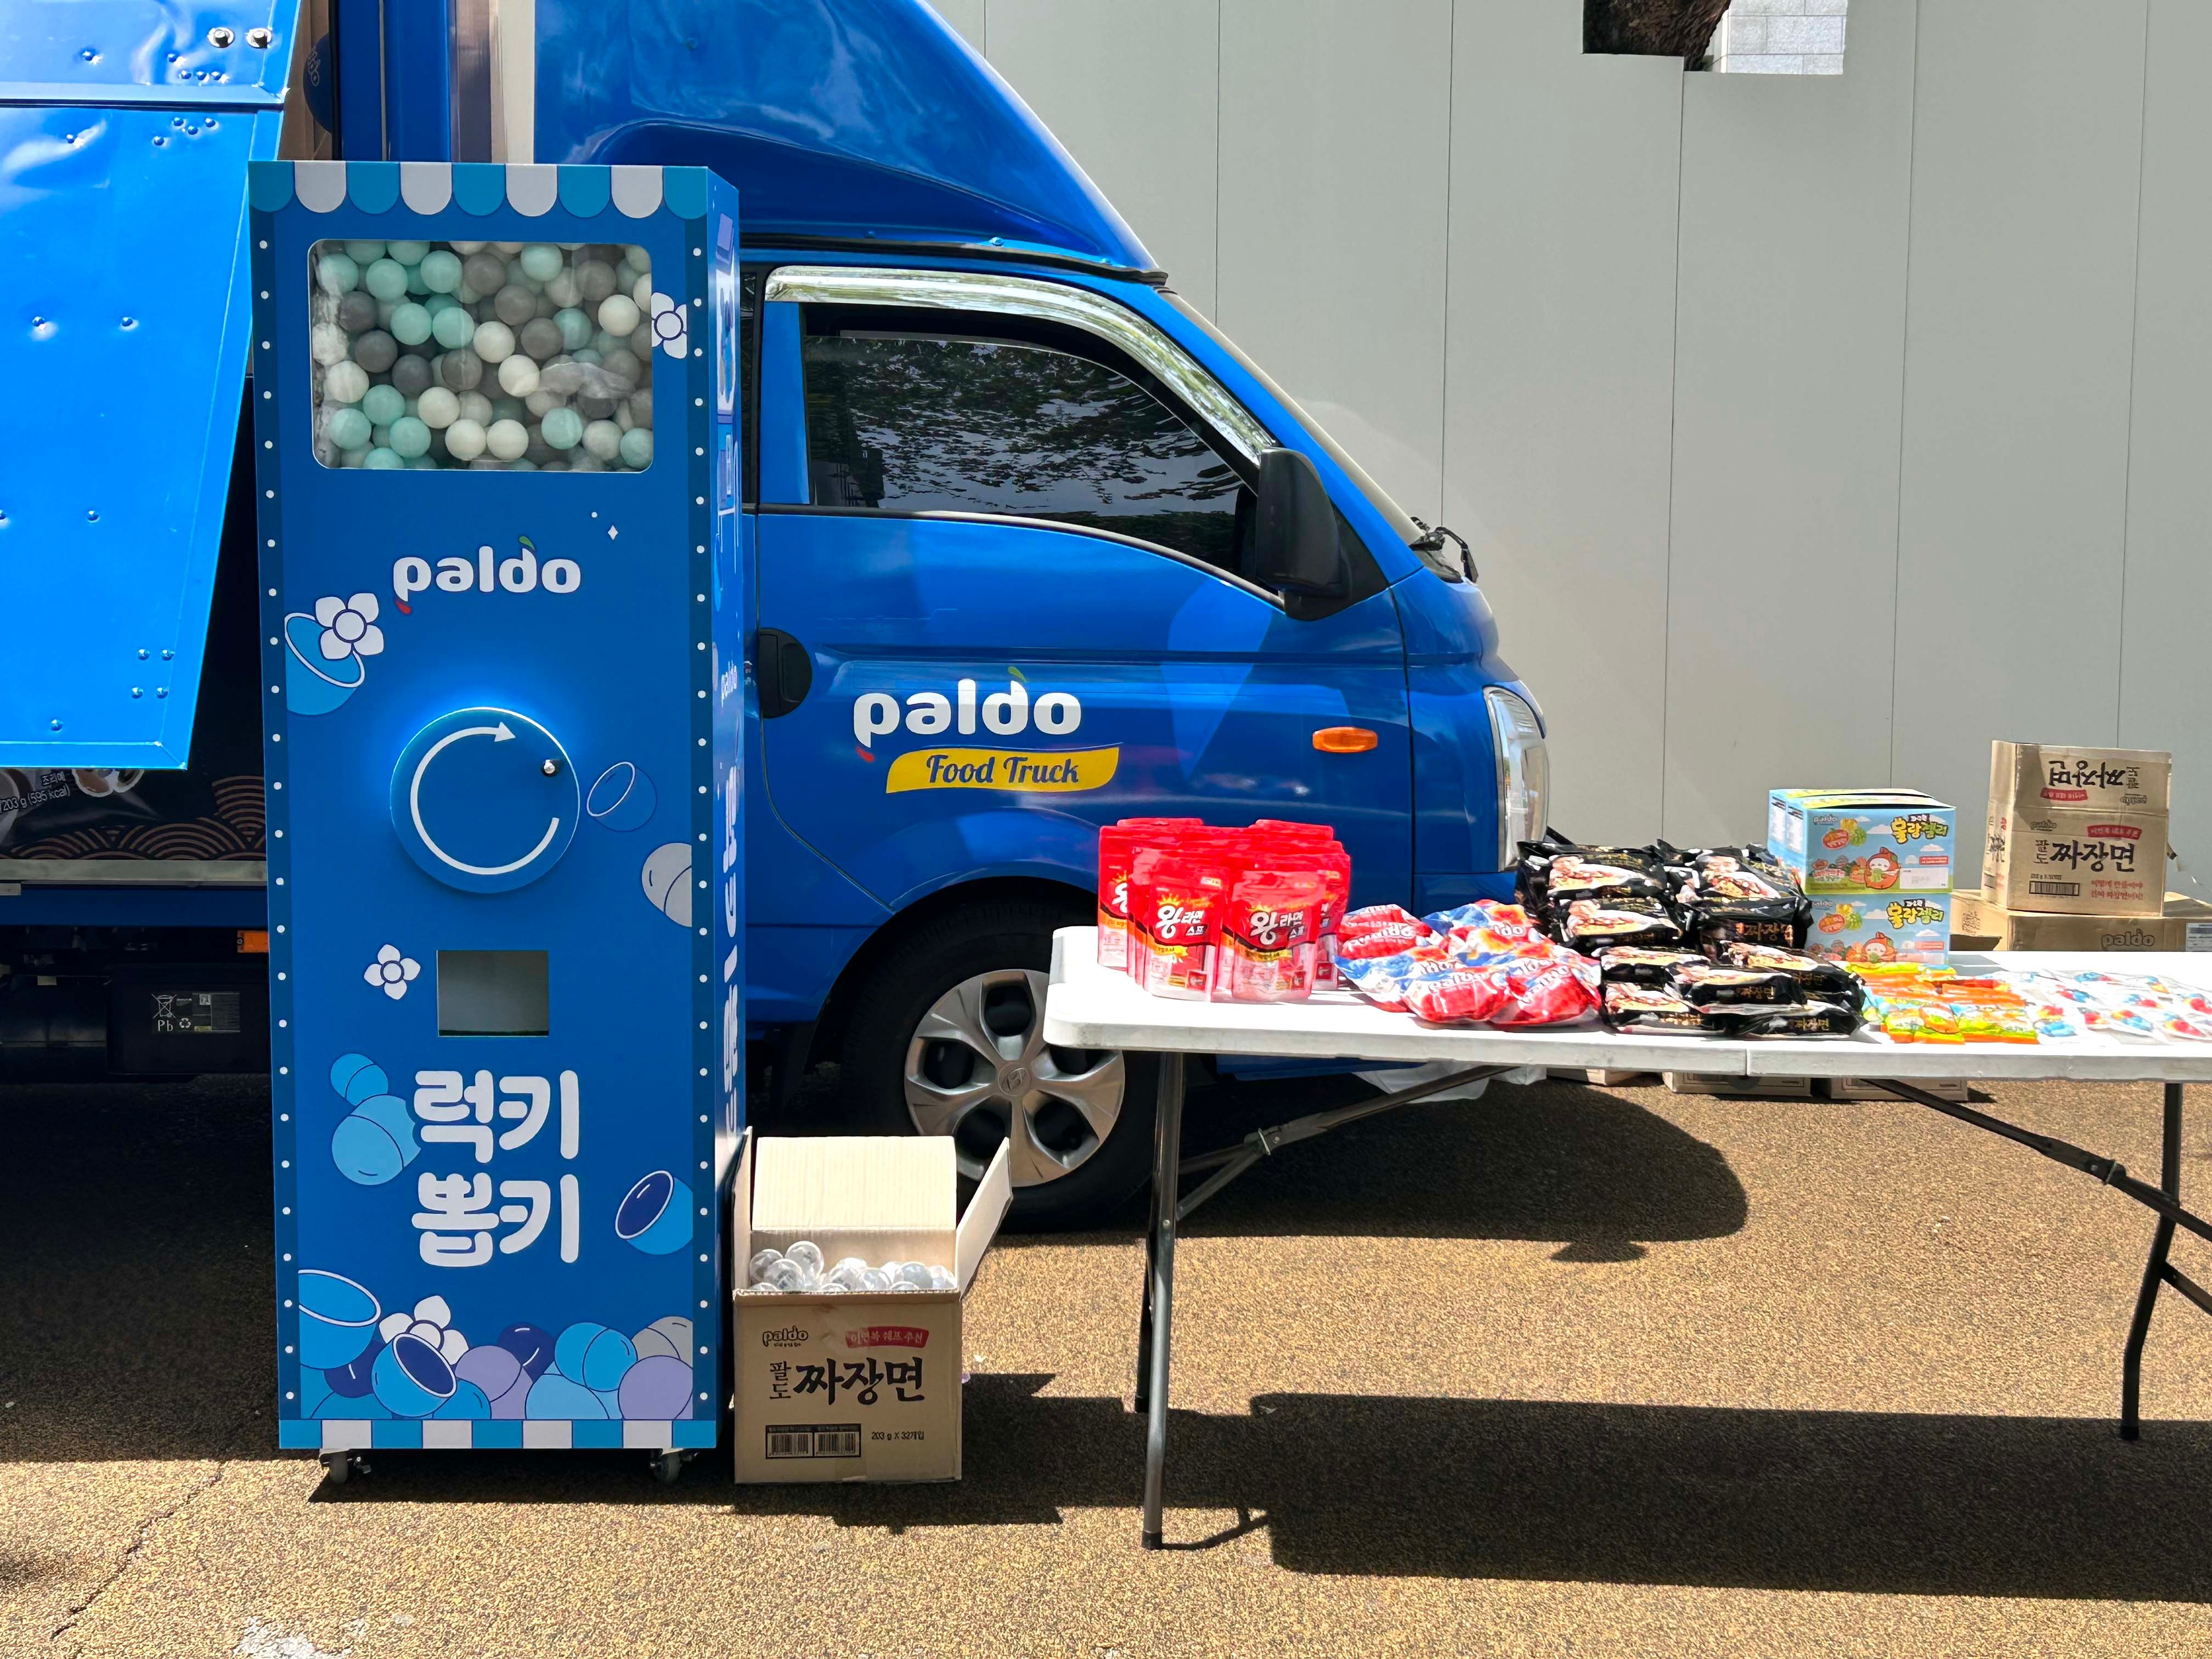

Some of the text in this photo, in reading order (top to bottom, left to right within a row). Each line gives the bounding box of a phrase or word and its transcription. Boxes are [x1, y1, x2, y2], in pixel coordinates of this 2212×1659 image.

[393, 539, 582, 610] paldo
[853, 670, 1082, 757] paldo
[926, 754, 1080, 783] Food Truck
[2048, 760, 2125, 789] 짜장면
[2050, 840, 2135, 872] 짜장면
[1494, 922, 1524, 936] ldo
[2101, 928, 2155, 949] paldo
[157, 1019, 173, 1032] Pb
[414, 1069, 580, 1164] 럭키
[411, 1172, 580, 1267] 뽑키
[763, 1325, 809, 1347] paldo
[793, 1357, 926, 1406] 짜장면
[871, 1431, 885, 1440] 203
